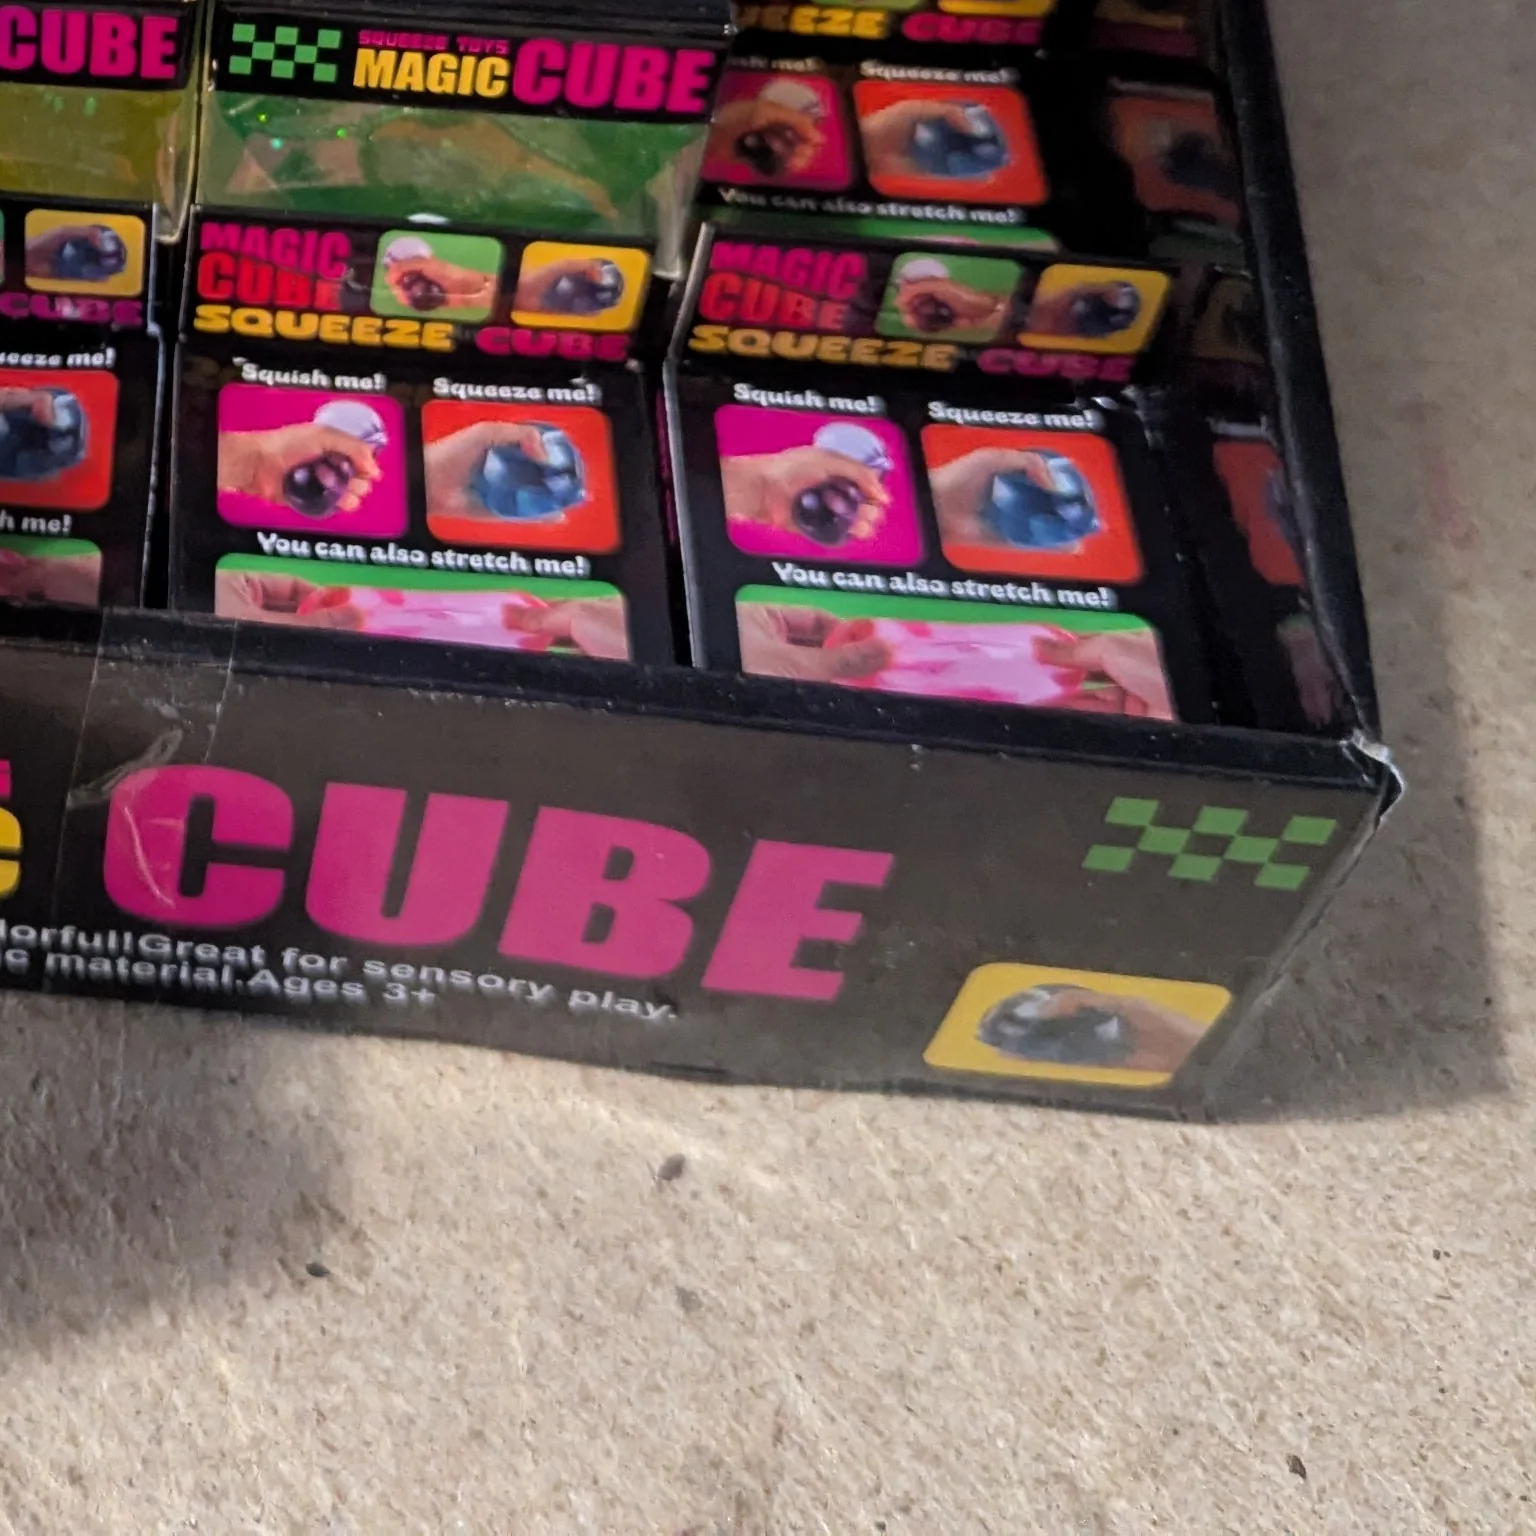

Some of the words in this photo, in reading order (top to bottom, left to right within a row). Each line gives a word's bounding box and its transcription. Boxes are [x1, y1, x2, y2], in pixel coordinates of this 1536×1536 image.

[352, 48, 512, 100] MAGIC
[513, 37, 716, 114] CUBE
[876, 202, 965, 222] stretch
[200, 222, 351, 279] MAGIC
[708, 240, 868, 301] MAGIC
[196, 252, 345, 311] CUBE
[699, 270, 851, 331] CUBE
[66, 347, 116, 368] me!
[193, 304, 457, 352] SQUEEZE
[475, 326, 631, 362] CUBE
[688, 325, 960, 372] SQUEEZE
[976, 348, 1132, 382] CUBE
[240, 361, 331, 389] Squish
[334, 371, 387, 391] me!
[431, 375, 543, 403] Squeeze
[546, 382, 602, 404] me!
[733, 381, 824, 410] Squish
[827, 392, 884, 415] me!
[927, 400, 1039, 428] Squeeze
[1042, 408, 1103, 432] me!
[20, 513, 73, 534] me!
[256, 531, 311, 558] You
[315, 539, 366, 562] can
[369, 542, 425, 566] also
[429, 545, 528, 575] stretch
[533, 555, 591, 579] me!
[771, 561, 828, 588] You
[831, 569, 885, 592] can
[888, 572, 947, 598] also
[950, 576, 1052, 606] stretch
[1055, 585, 1115, 611] me!
[104, 762, 895, 1002] CUBE
[280, 945, 350, 976] for
[362, 955, 556, 1003] sensory
[569, 983, 679, 1021] play.
[381, 980, 438, 1008] 3+
